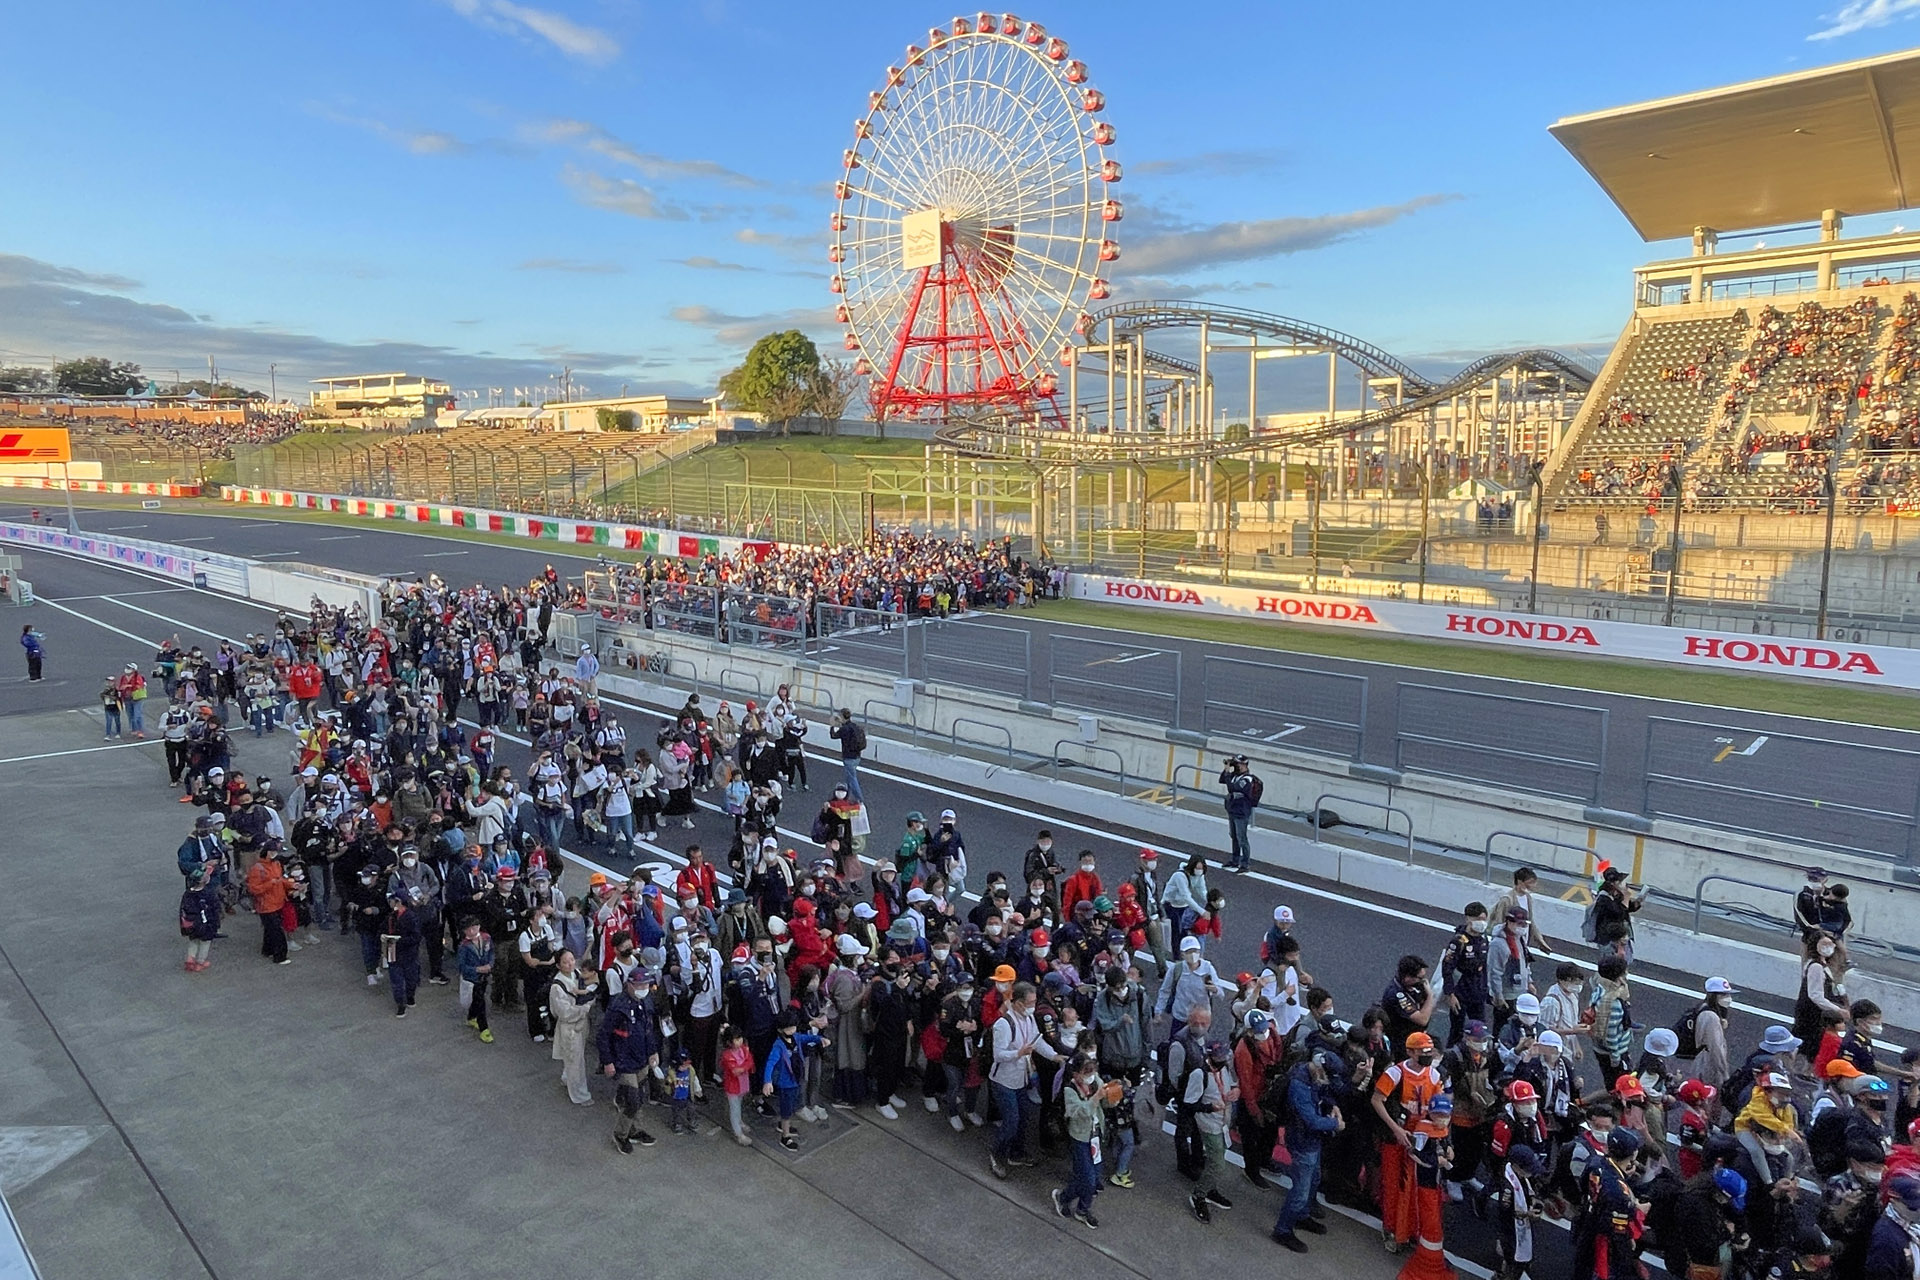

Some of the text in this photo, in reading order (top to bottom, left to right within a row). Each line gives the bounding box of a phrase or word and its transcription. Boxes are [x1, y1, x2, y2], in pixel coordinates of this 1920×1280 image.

[1105, 582, 1203, 605] HONDA
[1256, 596, 1378, 624] HONDA
[1446, 614, 1600, 646] HONDA
[1684, 637, 1884, 675] HONDA
